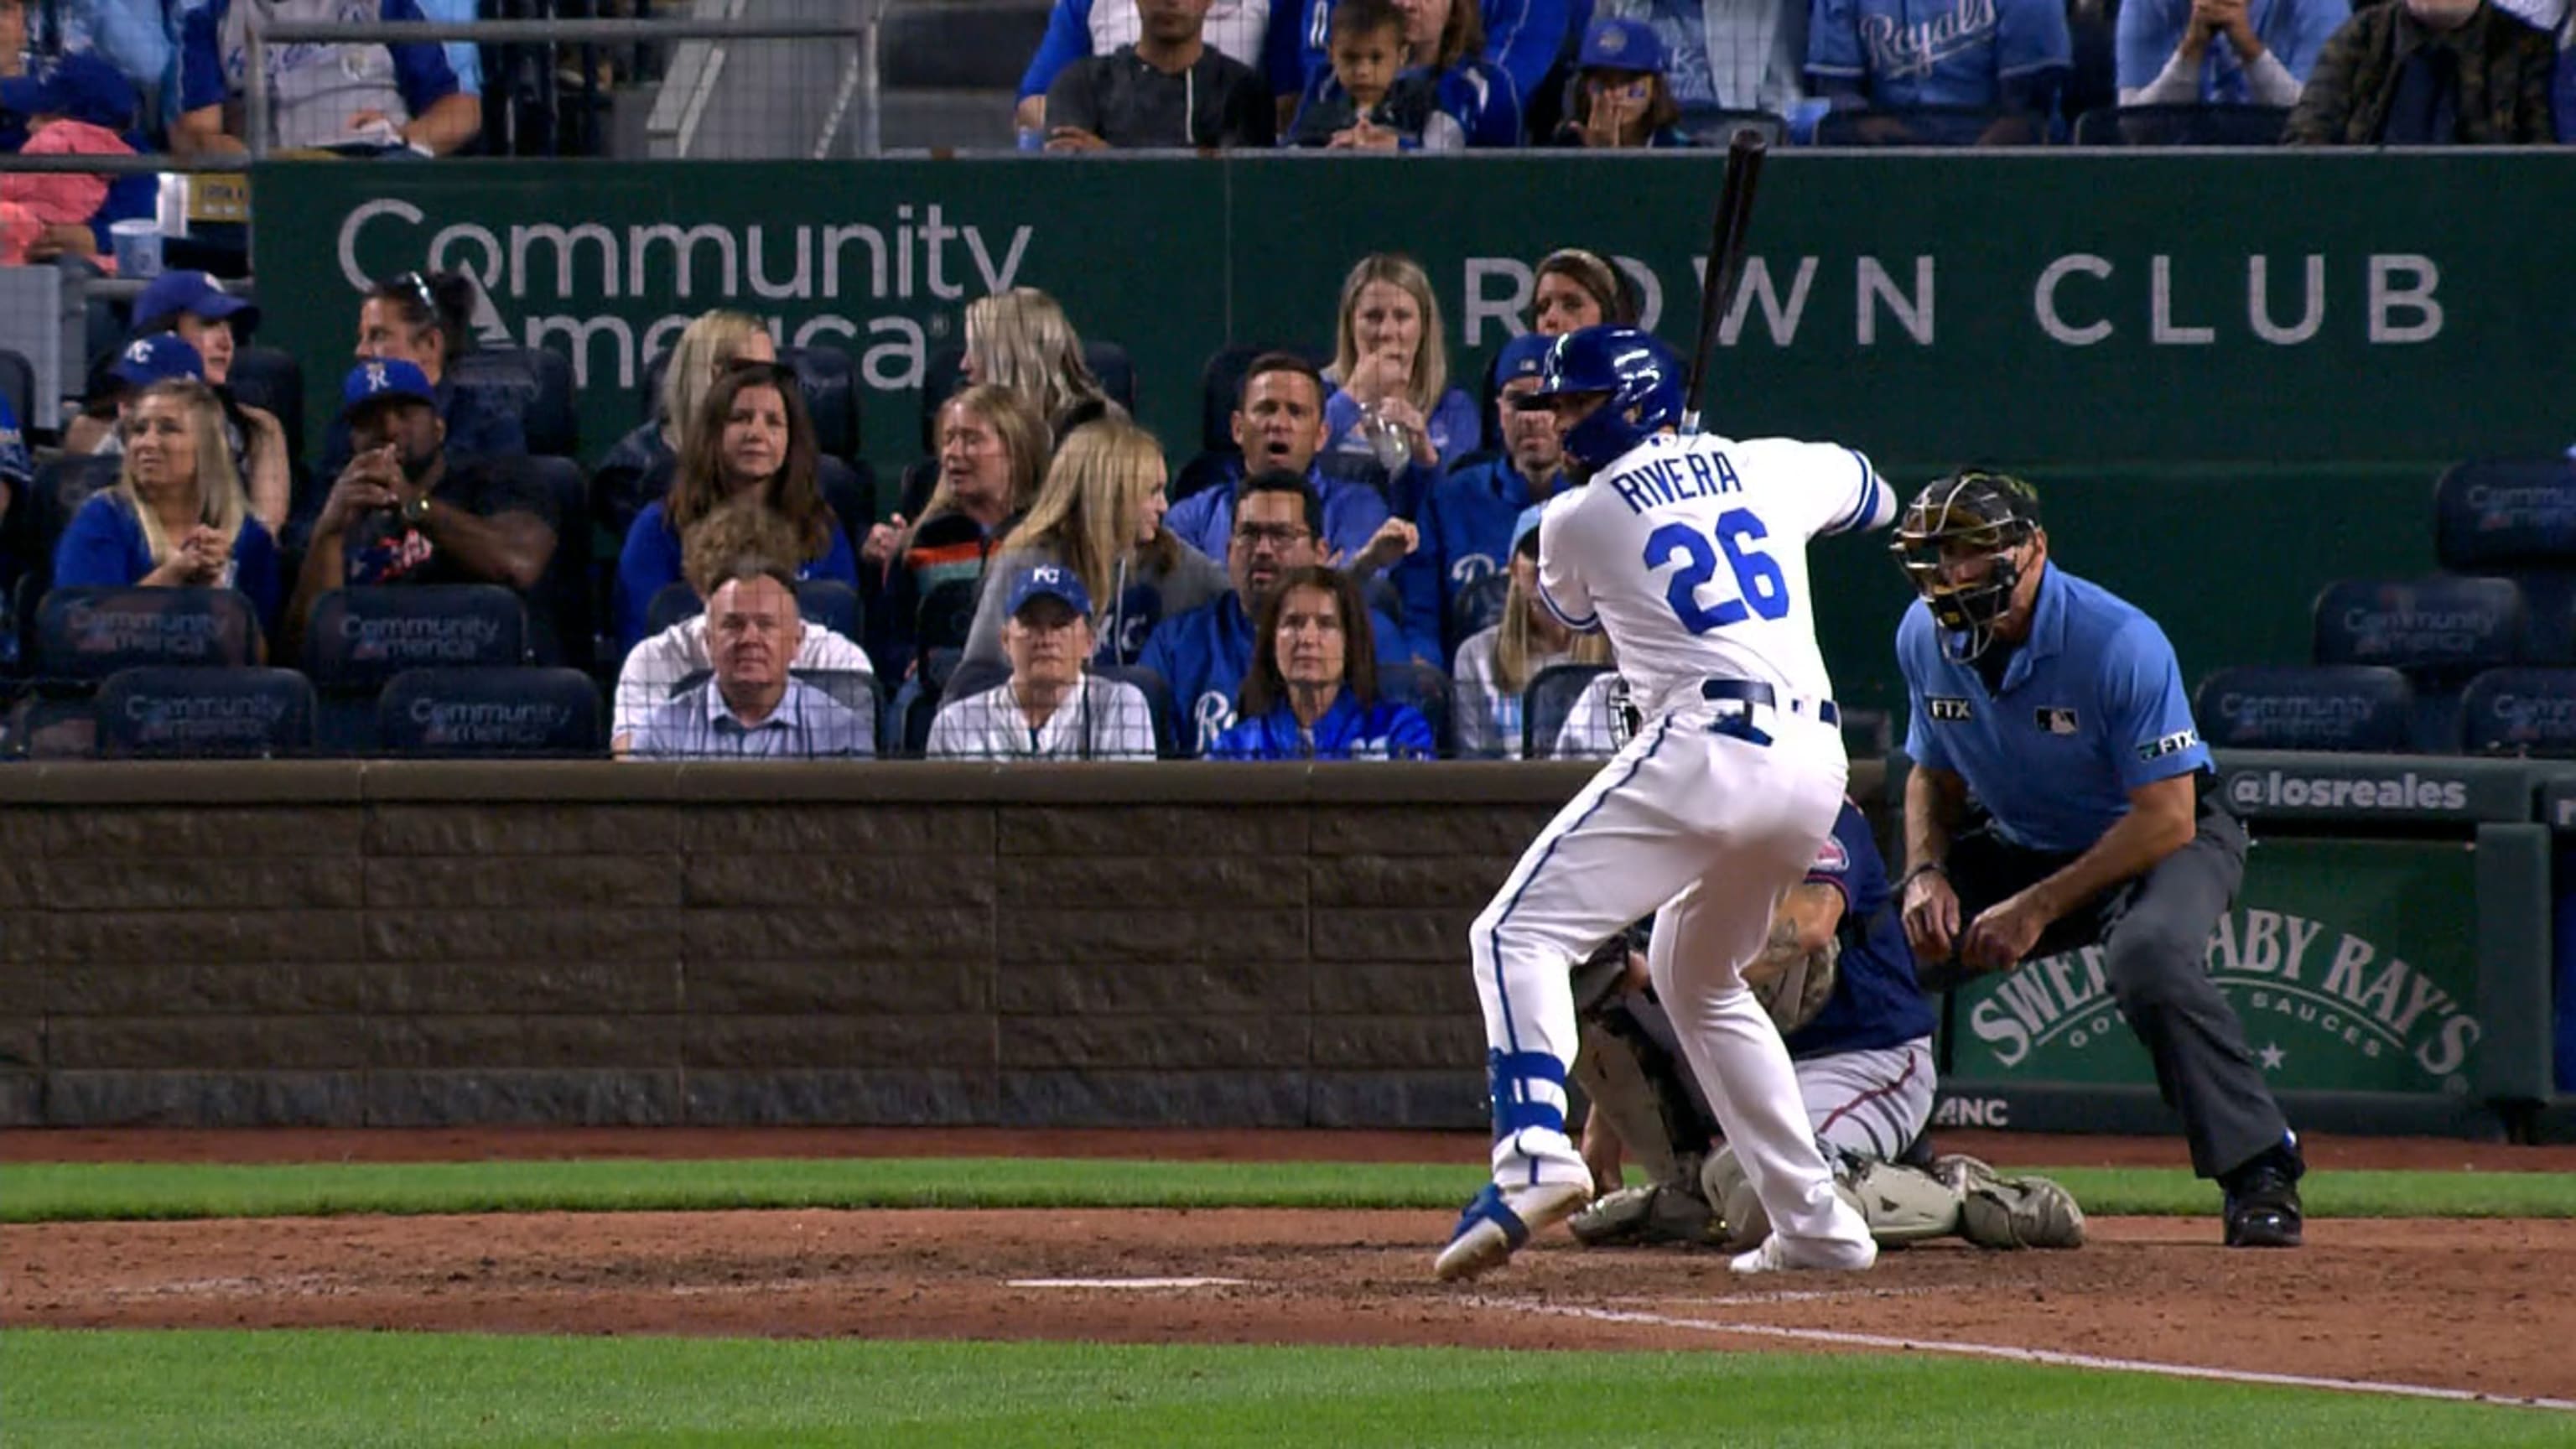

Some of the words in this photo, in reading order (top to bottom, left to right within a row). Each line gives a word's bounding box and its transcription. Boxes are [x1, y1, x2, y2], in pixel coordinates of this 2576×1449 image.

[338, 198, 1033, 300] Community
[2034, 254, 2444, 345] CLUB
[1610, 451, 1742, 515] RIVERA
[1643, 507, 1789, 636] 26
[1932, 699, 1970, 719] FTX
[2158, 730, 2196, 755] FTX
[2226, 771, 2468, 813] @losreales
[2251, 991, 2382, 1059] SAUCES
[2323, 933, 2480, 1074] RAY'S
[1935, 1096, 2008, 1127] ANC
